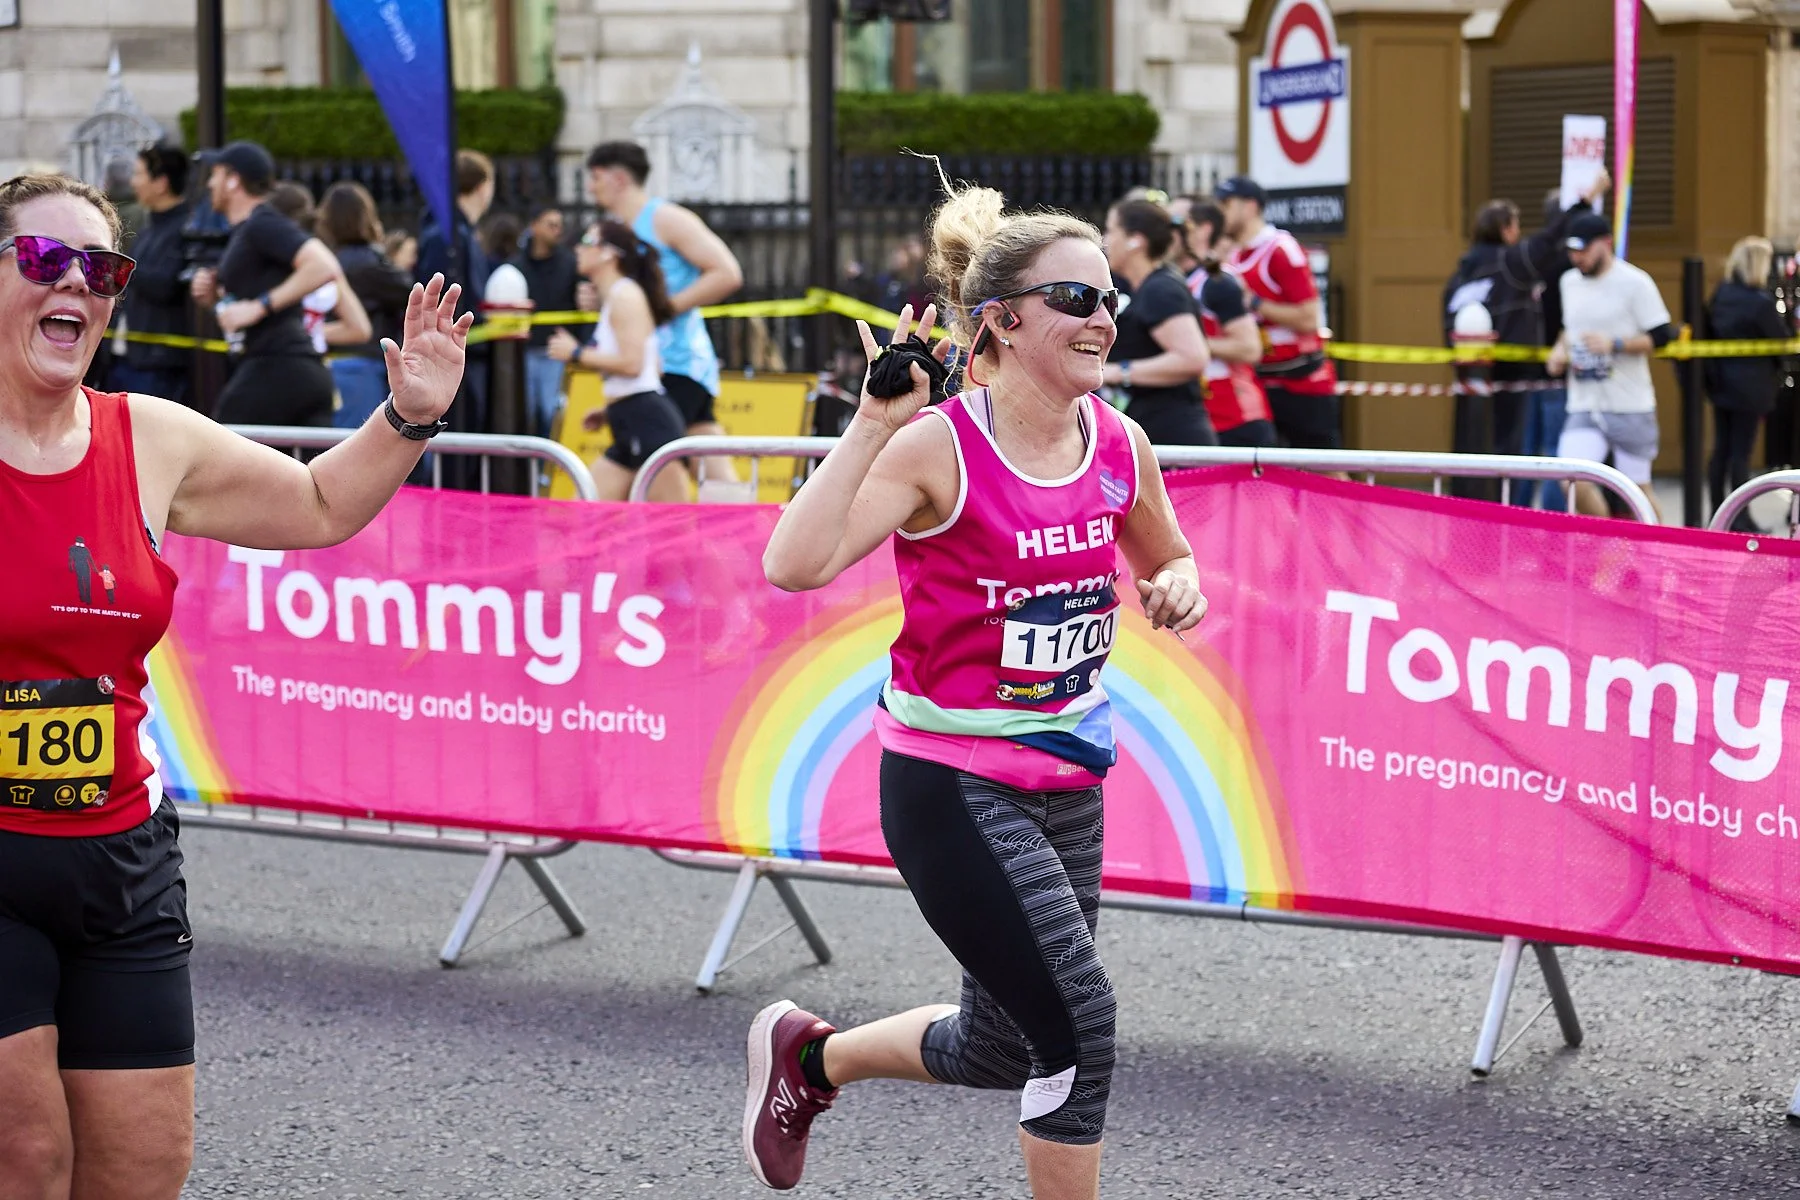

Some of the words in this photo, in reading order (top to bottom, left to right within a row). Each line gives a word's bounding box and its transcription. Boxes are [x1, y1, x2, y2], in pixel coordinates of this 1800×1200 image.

[1015, 515, 1114, 559] HELEN
[101, 609, 121, 617] MATCH
[228, 544, 666, 685] Tommy's
[1064, 596, 1099, 611] HELEN
[1018, 612, 1114, 665] 11700
[5, 688, 41, 703] LISA
[231, 664, 276, 697] The
[280, 678, 414, 720] pregnancy
[419, 691, 472, 720] and
[480, 692, 553, 734] baby
[561, 700, 666, 741] charity
[1325, 589, 1790, 782] Tommy
[0, 718, 102, 766] 180
[1319, 736, 1376, 772] The
[1385, 752, 1567, 803] pregnancy
[1577, 782, 1637, 814] and
[1649, 785, 1742, 838] baby
